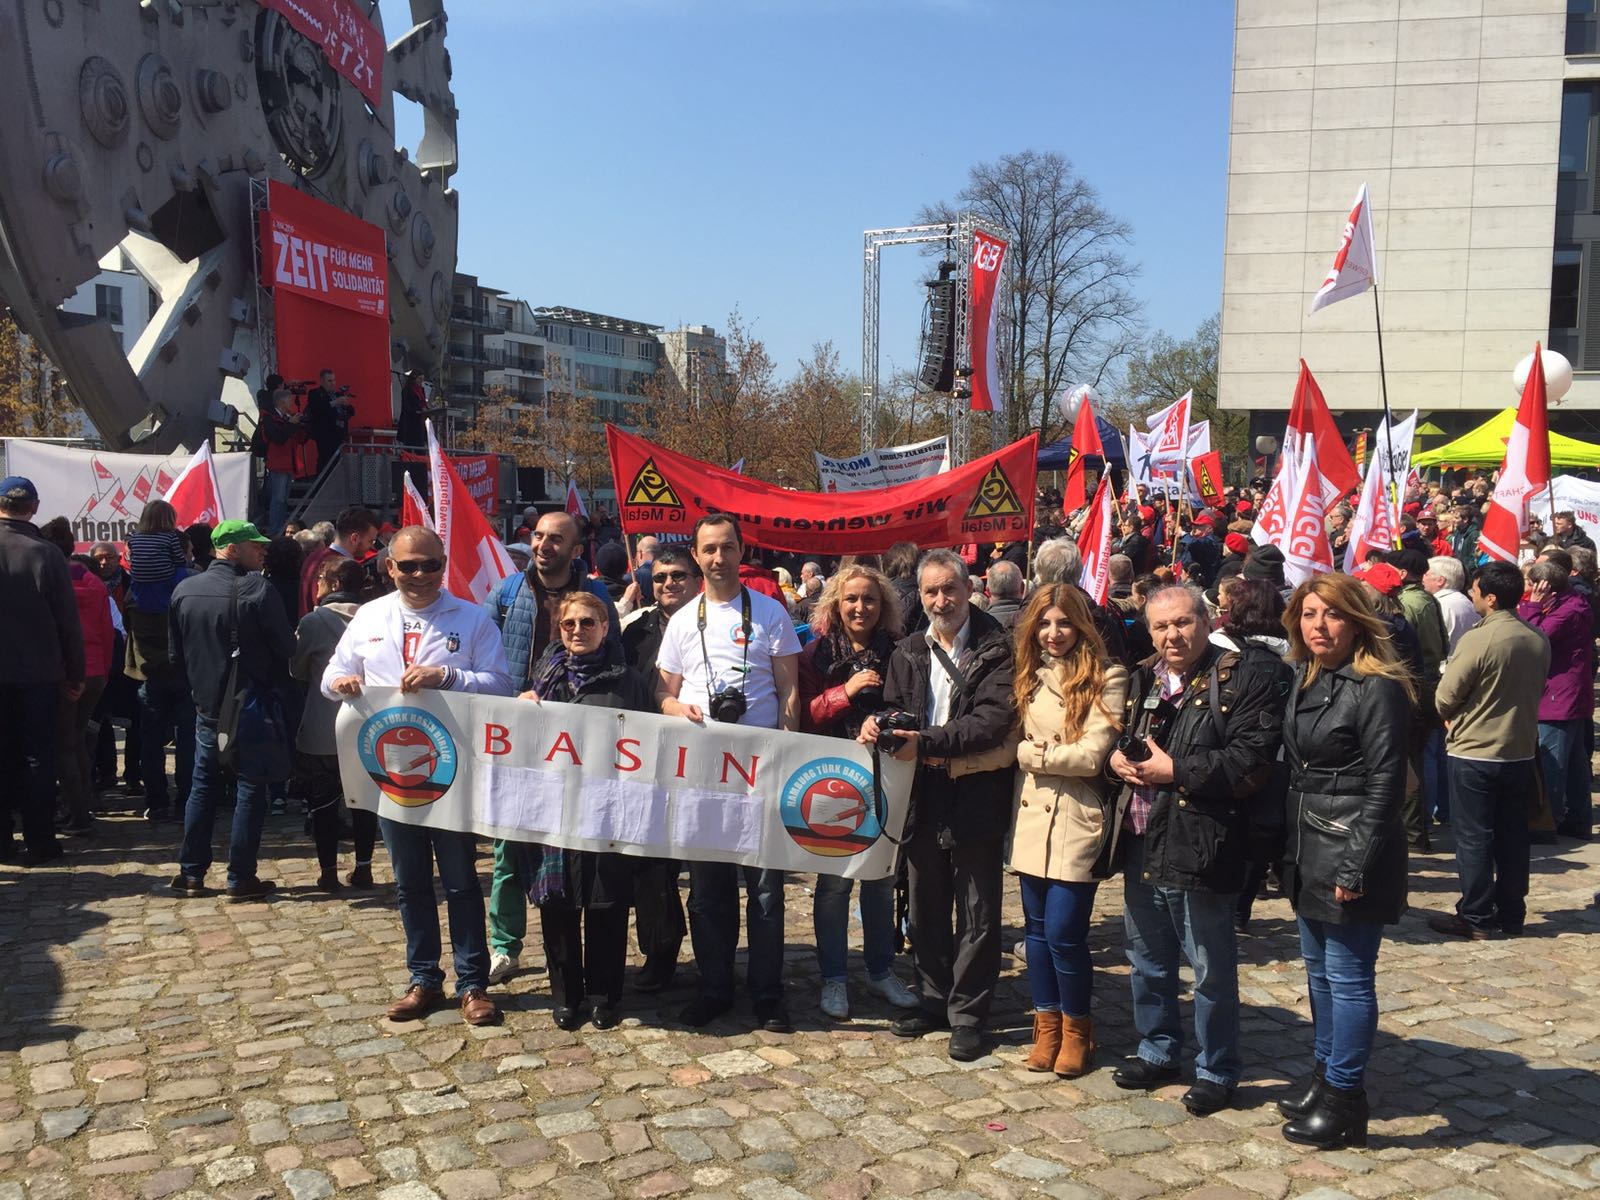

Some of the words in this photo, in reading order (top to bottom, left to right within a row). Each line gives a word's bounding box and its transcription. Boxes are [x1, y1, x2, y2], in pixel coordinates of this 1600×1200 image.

[272, 230, 328, 292] ZEIT
[330, 246, 348, 267] FÜR
[348, 252, 374, 272] MEHR
[331, 270, 385, 296] SOLIDARITÄT
[1577, 509, 1599, 525] UNS
[382, 713, 408, 726] TÜRK
[483, 722, 761, 789] BASIN
[786, 768, 817, 808] HAMBURG
[815, 763, 841, 775] TÜRK
